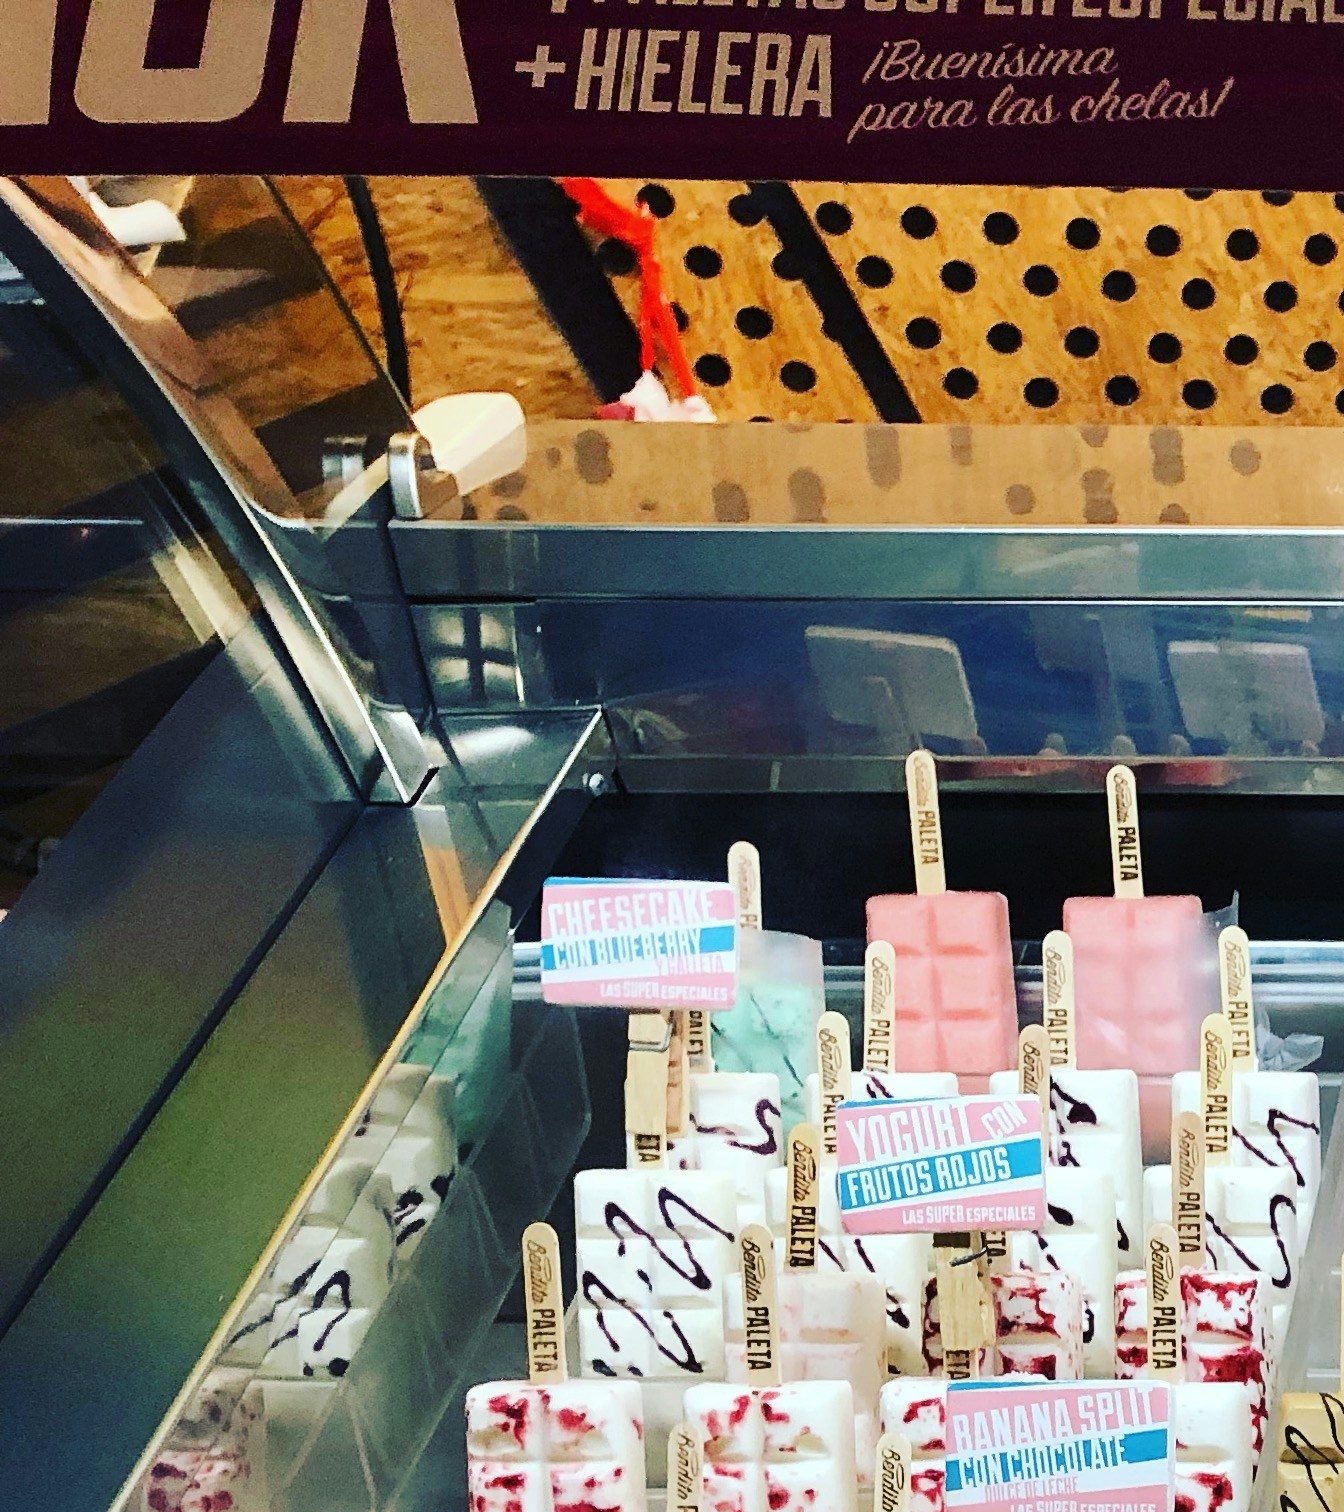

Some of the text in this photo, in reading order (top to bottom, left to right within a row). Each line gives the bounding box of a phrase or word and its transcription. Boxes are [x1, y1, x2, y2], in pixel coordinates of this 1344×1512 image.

[574, 28, 832, 118] HIELERA
[861, 39, 1119, 84] ¡Buenísima
[847, 76, 1234, 144] para las chelas!
[918, 811, 939, 866] PALETA
[1117, 828, 1138, 881] PALETA
[548, 888, 718, 937] CHEESECAKE
[554, 927, 701, 969] CON BLUEBERRY
[846, 1100, 1028, 1164] YOGURT CON
[847, 1147, 1011, 1207] FRUTOS ROJOS
[902, 1205, 1036, 1224] LAS SUPER ESPECIALES
[528, 1307, 561, 1373] PALETA
[953, 1387, 1154, 1454] BANANA SPLIT
[959, 1434, 1130, 1488] CON CHOCOLATE
[984, 1475, 1079, 1503] DULCE DE LECHE
